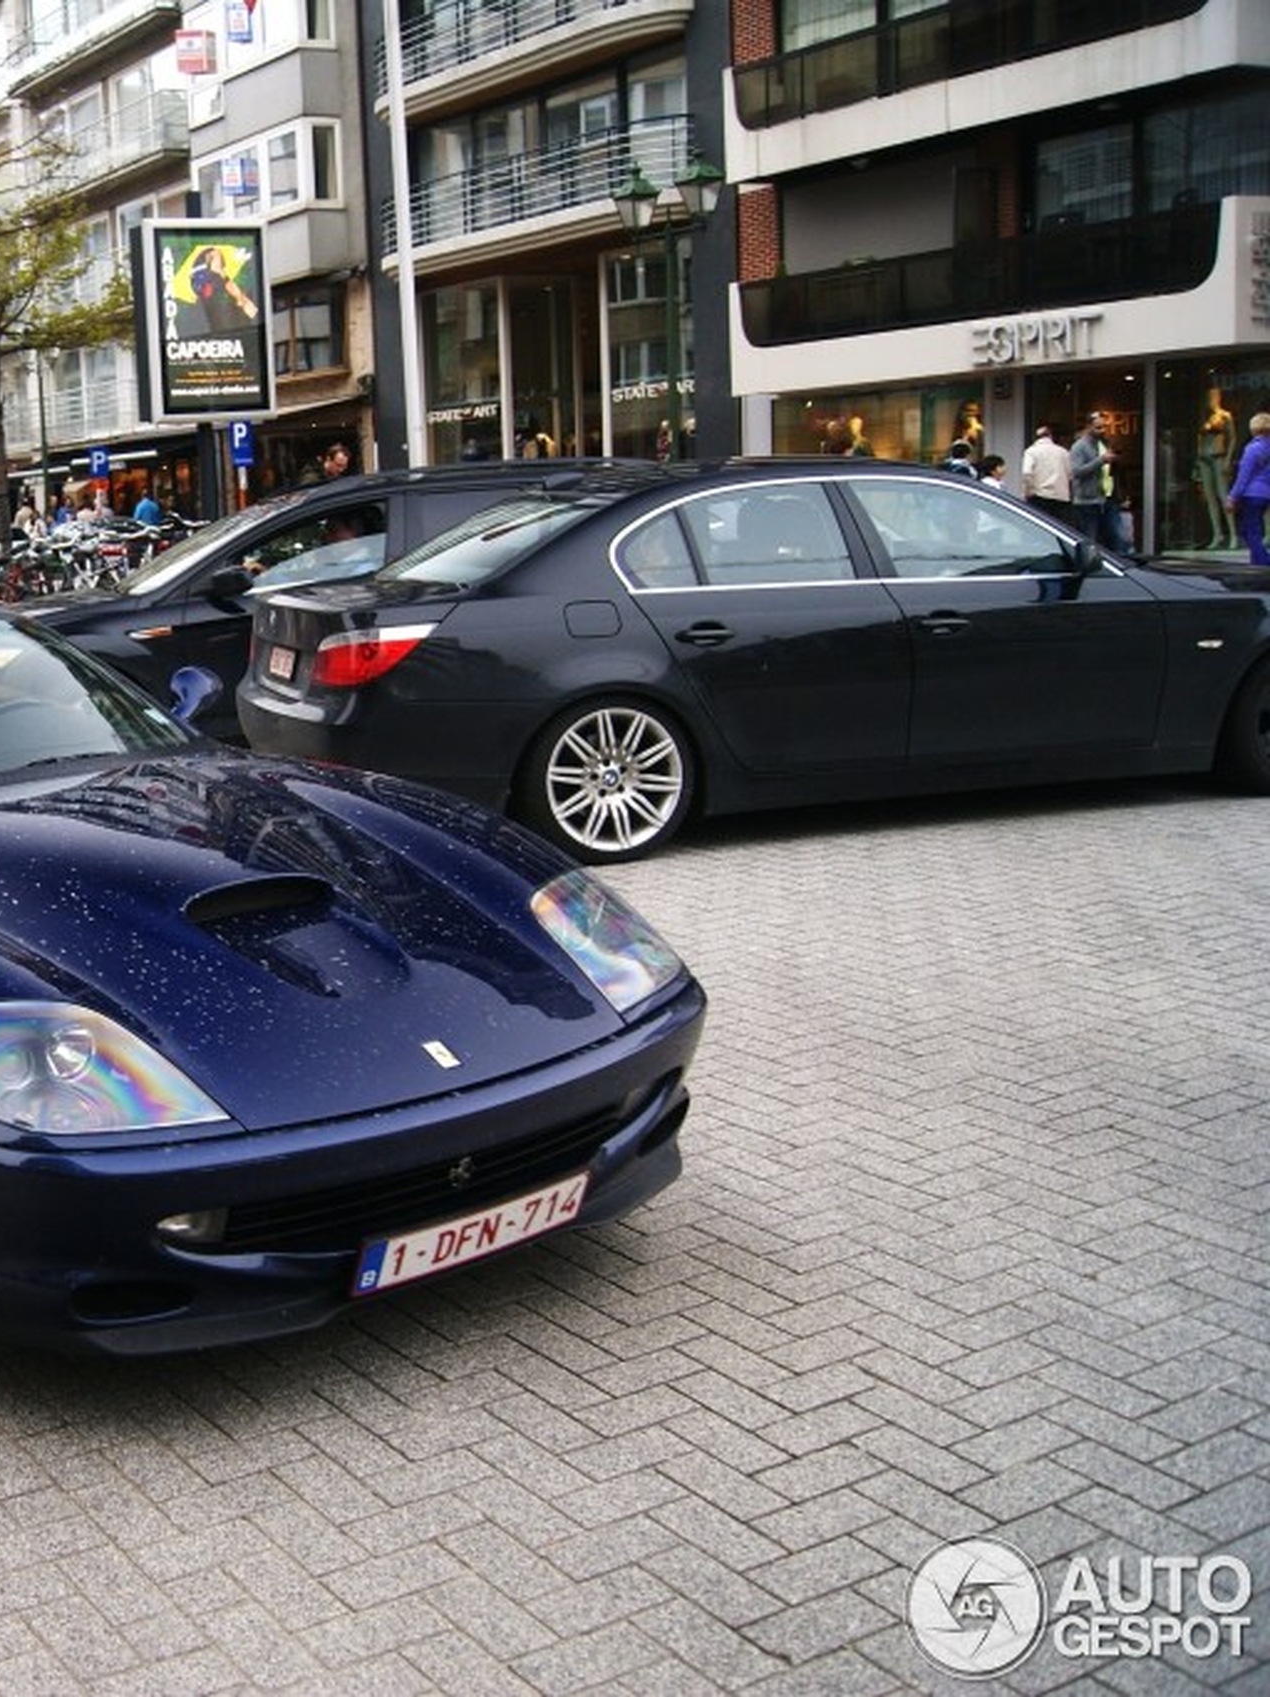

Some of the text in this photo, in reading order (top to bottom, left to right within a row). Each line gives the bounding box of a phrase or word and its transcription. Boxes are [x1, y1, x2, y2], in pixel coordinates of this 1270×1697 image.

[167, 339, 244, 360] CAPOEIRA
[972, 314, 1103, 368] ESPRIT
[612, 382, 660, 403] STATE
[473, 404, 498, 418] ART
[233, 423, 247, 448] P
[93, 451, 106, 473] P
[393, 1182, 581, 1277] 1-DFN-714
